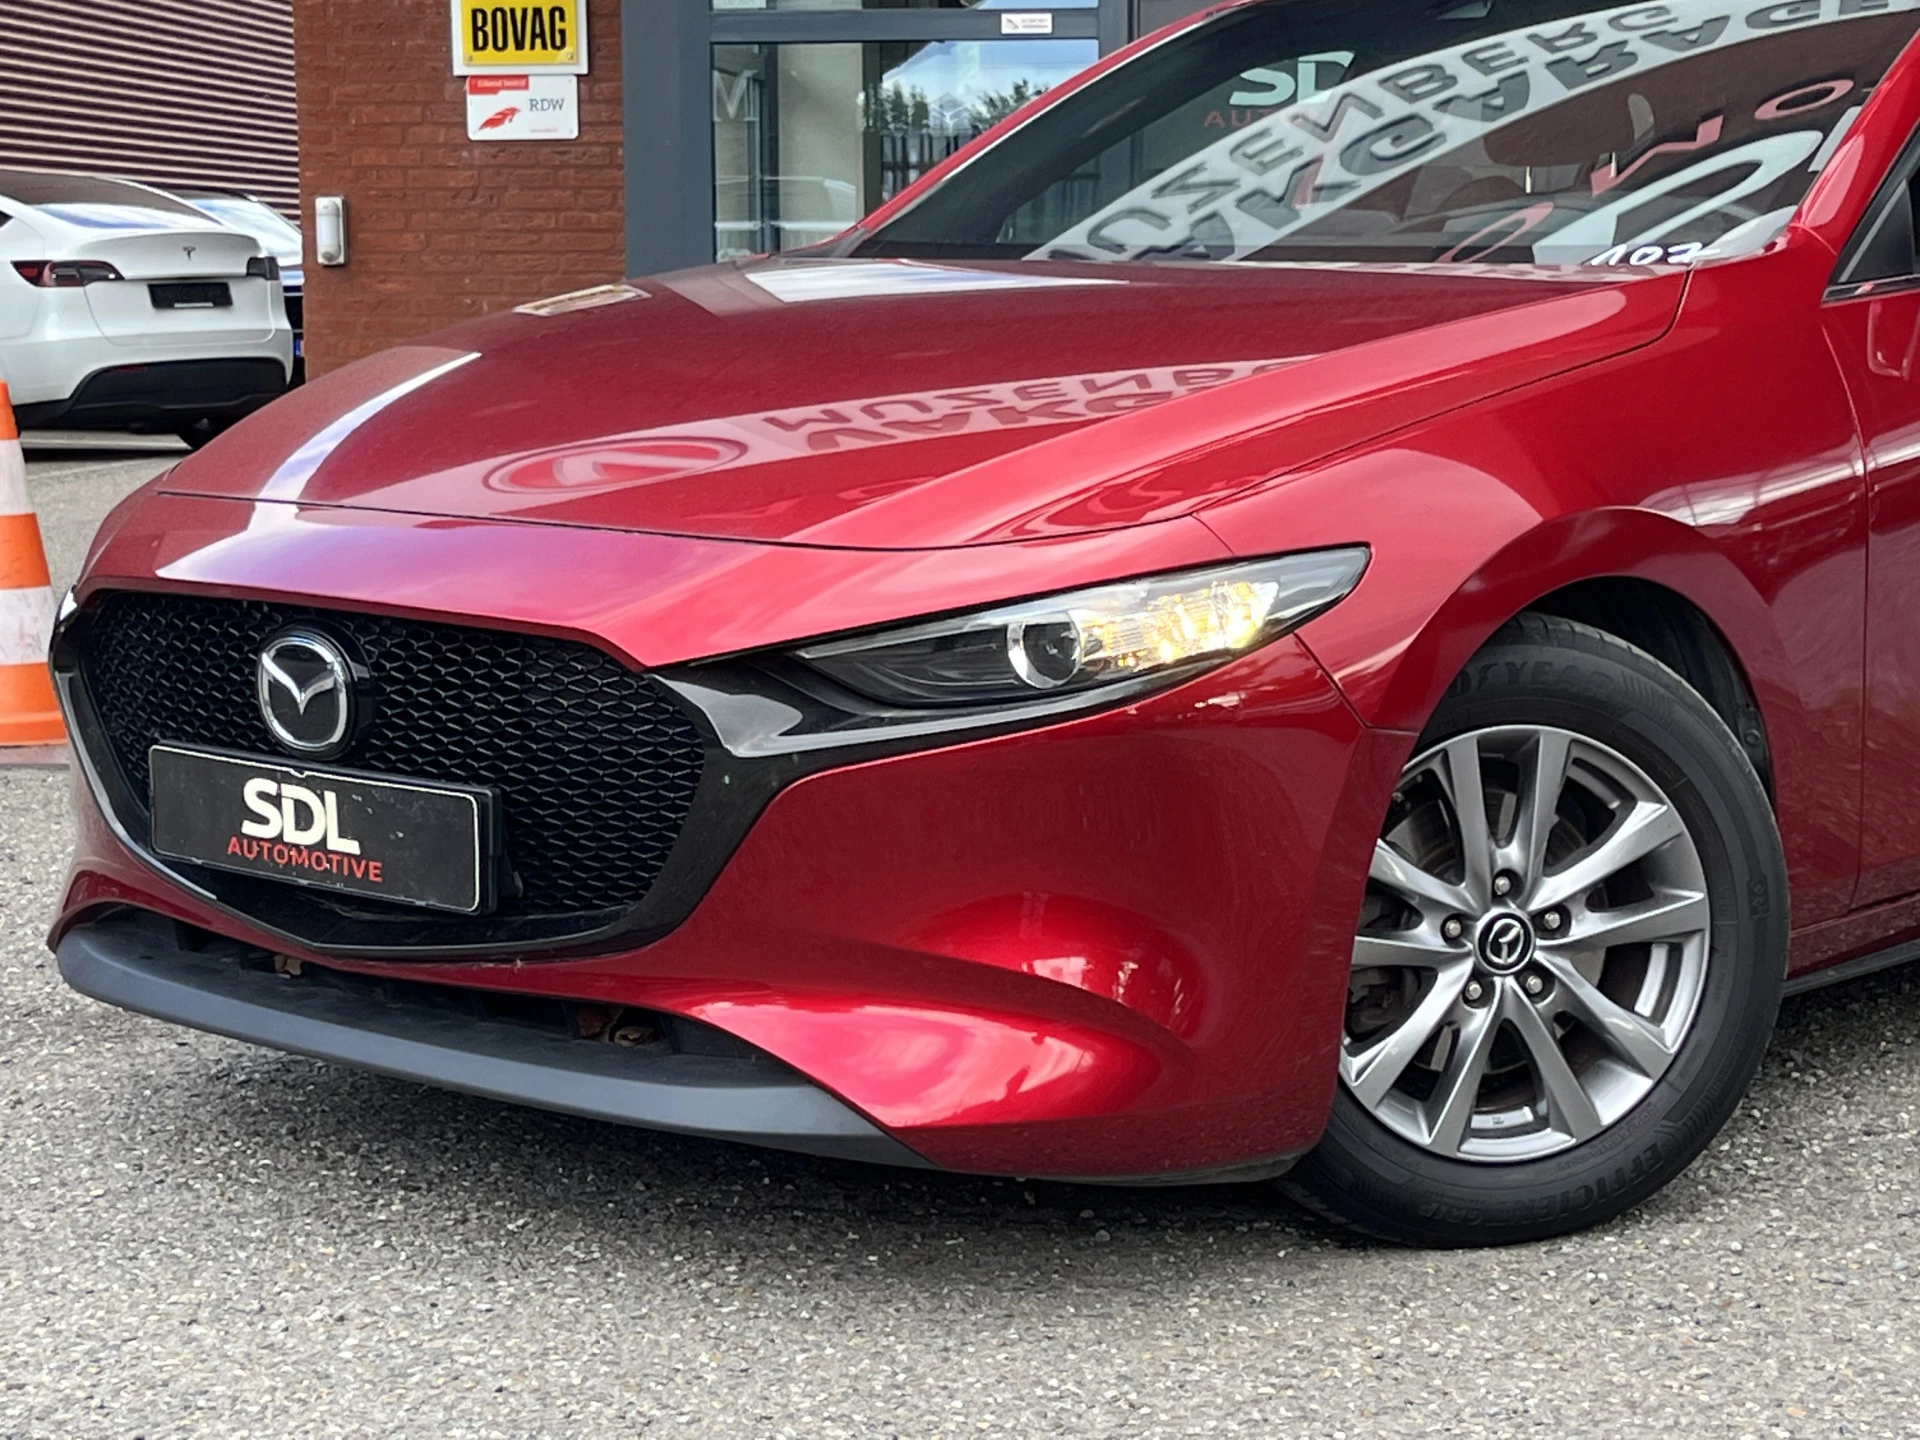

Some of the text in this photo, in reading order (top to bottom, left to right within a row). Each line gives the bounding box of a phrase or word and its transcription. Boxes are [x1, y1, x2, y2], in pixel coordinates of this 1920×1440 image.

[471, 6, 567, 52] BOVAG
[528, 98, 565, 112] RDW
[241, 777, 361, 855] SDL
[226, 836, 383, 882] AUTOMOTIVE
